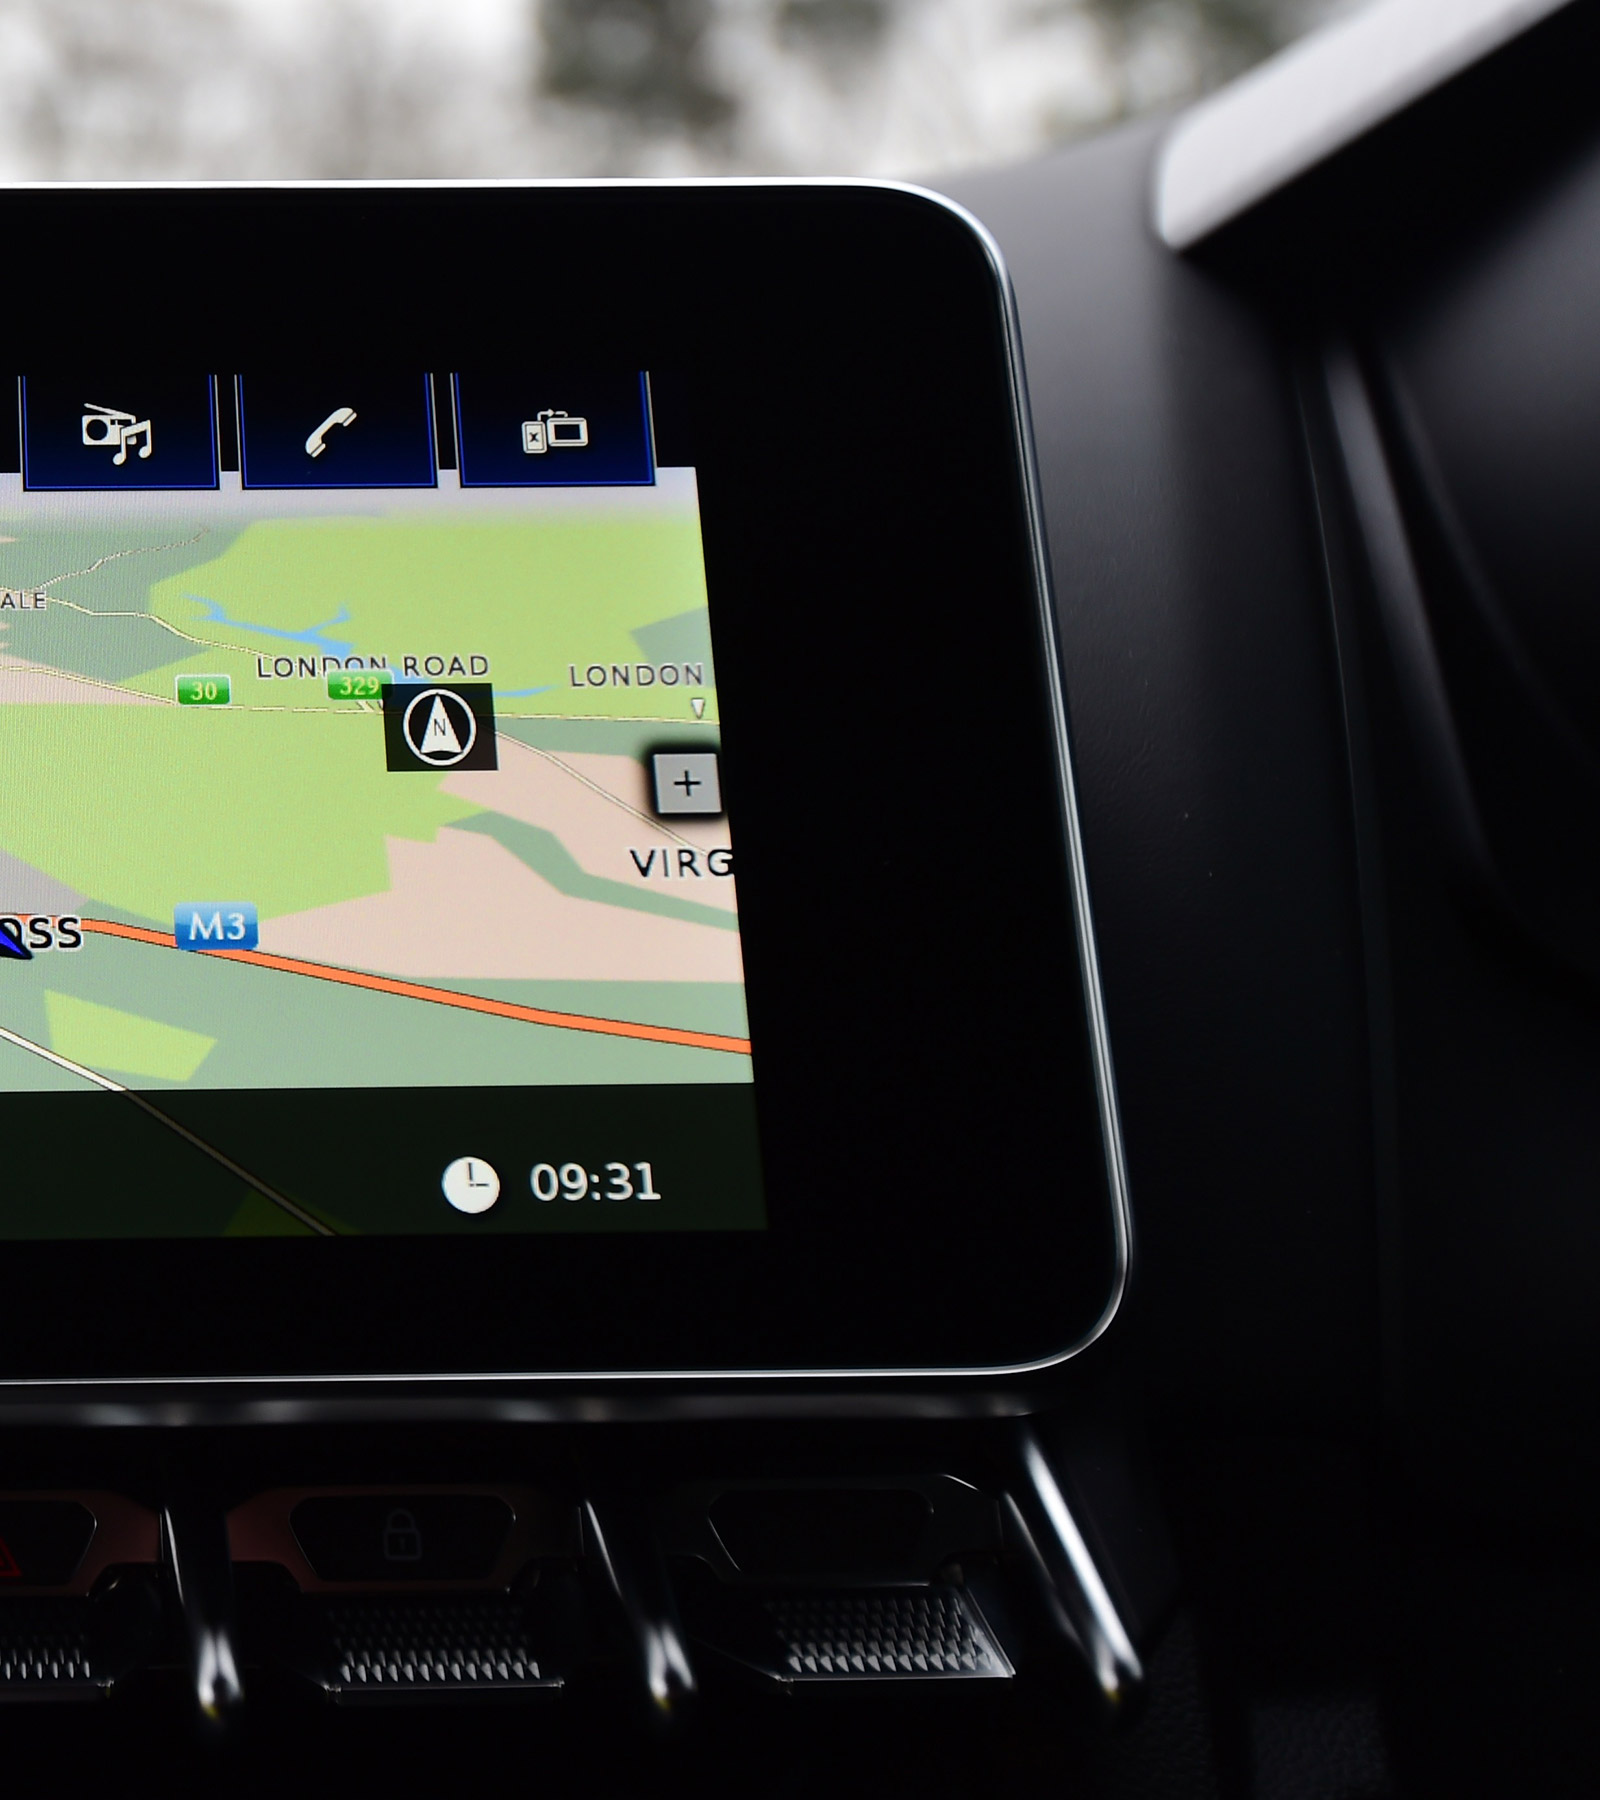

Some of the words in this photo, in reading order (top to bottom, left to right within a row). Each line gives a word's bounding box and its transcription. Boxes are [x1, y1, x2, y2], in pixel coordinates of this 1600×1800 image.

[403, 655, 489, 677] ROAD
[569, 664, 703, 687] LONDON
[190, 681, 218, 701] 30
[339, 676, 380, 696] 329
[433, 718, 447, 737] N
[629, 848, 734, 878] VIRG
[187, 911, 247, 941] M3
[530, 1161, 662, 1202] 09:31
